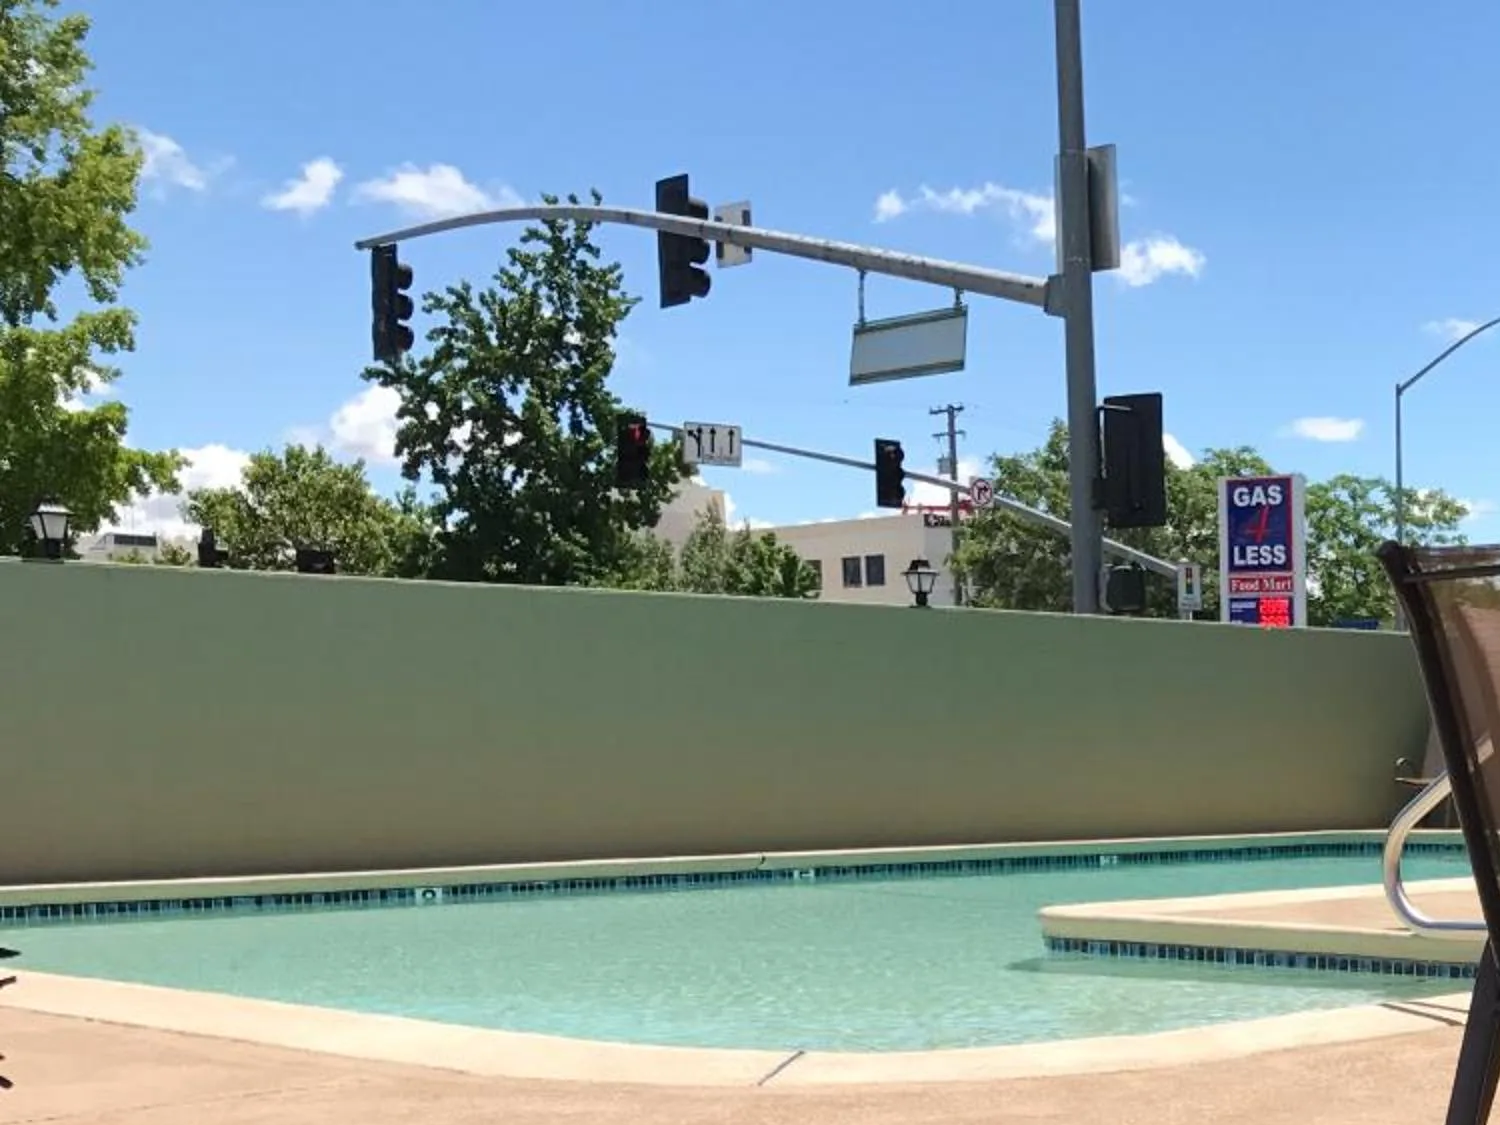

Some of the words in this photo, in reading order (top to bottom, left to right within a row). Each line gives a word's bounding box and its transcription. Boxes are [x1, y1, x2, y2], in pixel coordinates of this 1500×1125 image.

[1233, 485, 1283, 507] GAS
[1233, 545, 1286, 566] LESS
[1231, 579, 1259, 591] Food
[1263, 577, 1291, 590] Mart
